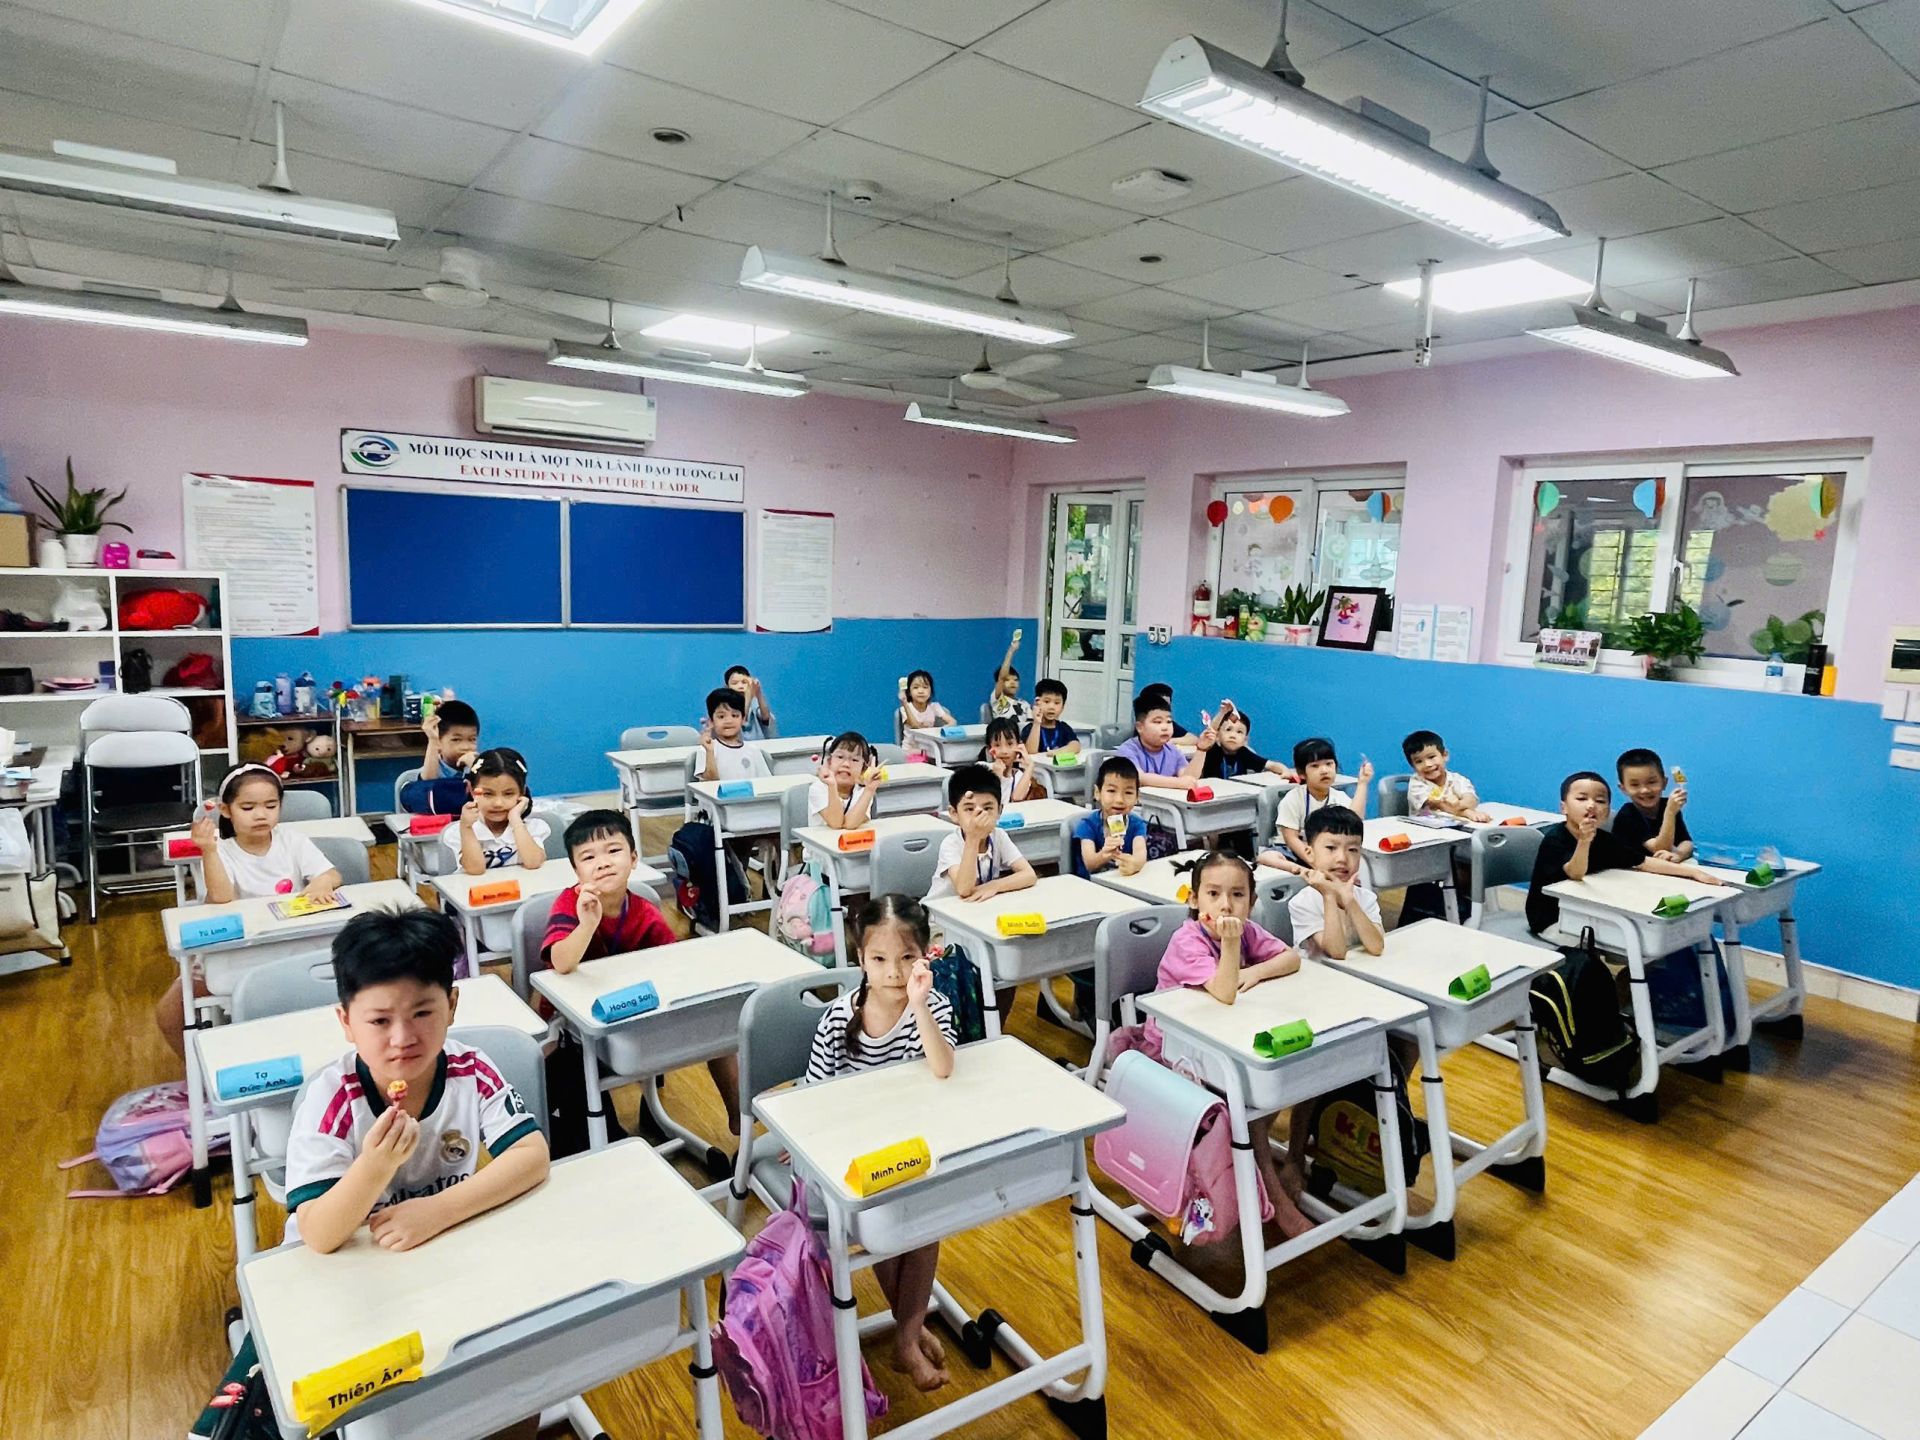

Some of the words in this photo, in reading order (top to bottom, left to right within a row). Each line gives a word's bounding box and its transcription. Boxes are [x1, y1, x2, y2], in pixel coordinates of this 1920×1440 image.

[444, 446, 477, 459] HỌC
[480, 449, 514, 462] SINH
[719, 471, 739, 482] LAI
[460, 464, 500, 478] EACH
[504, 468, 565, 482] STUDENT
[571, 474, 582, 484] IS
[587, 476, 594, 484] A
[598, 475, 646, 489] FUTURE
[651, 479, 699, 493] LEADER
[265, 1078, 287, 1088] Anh
[871, 1166, 894, 1182] Minh
[896, 1157, 922, 1171] Châu
[328, 1381, 375, 1409] Thiên
[380, 1367, 403, 1385] Ân
